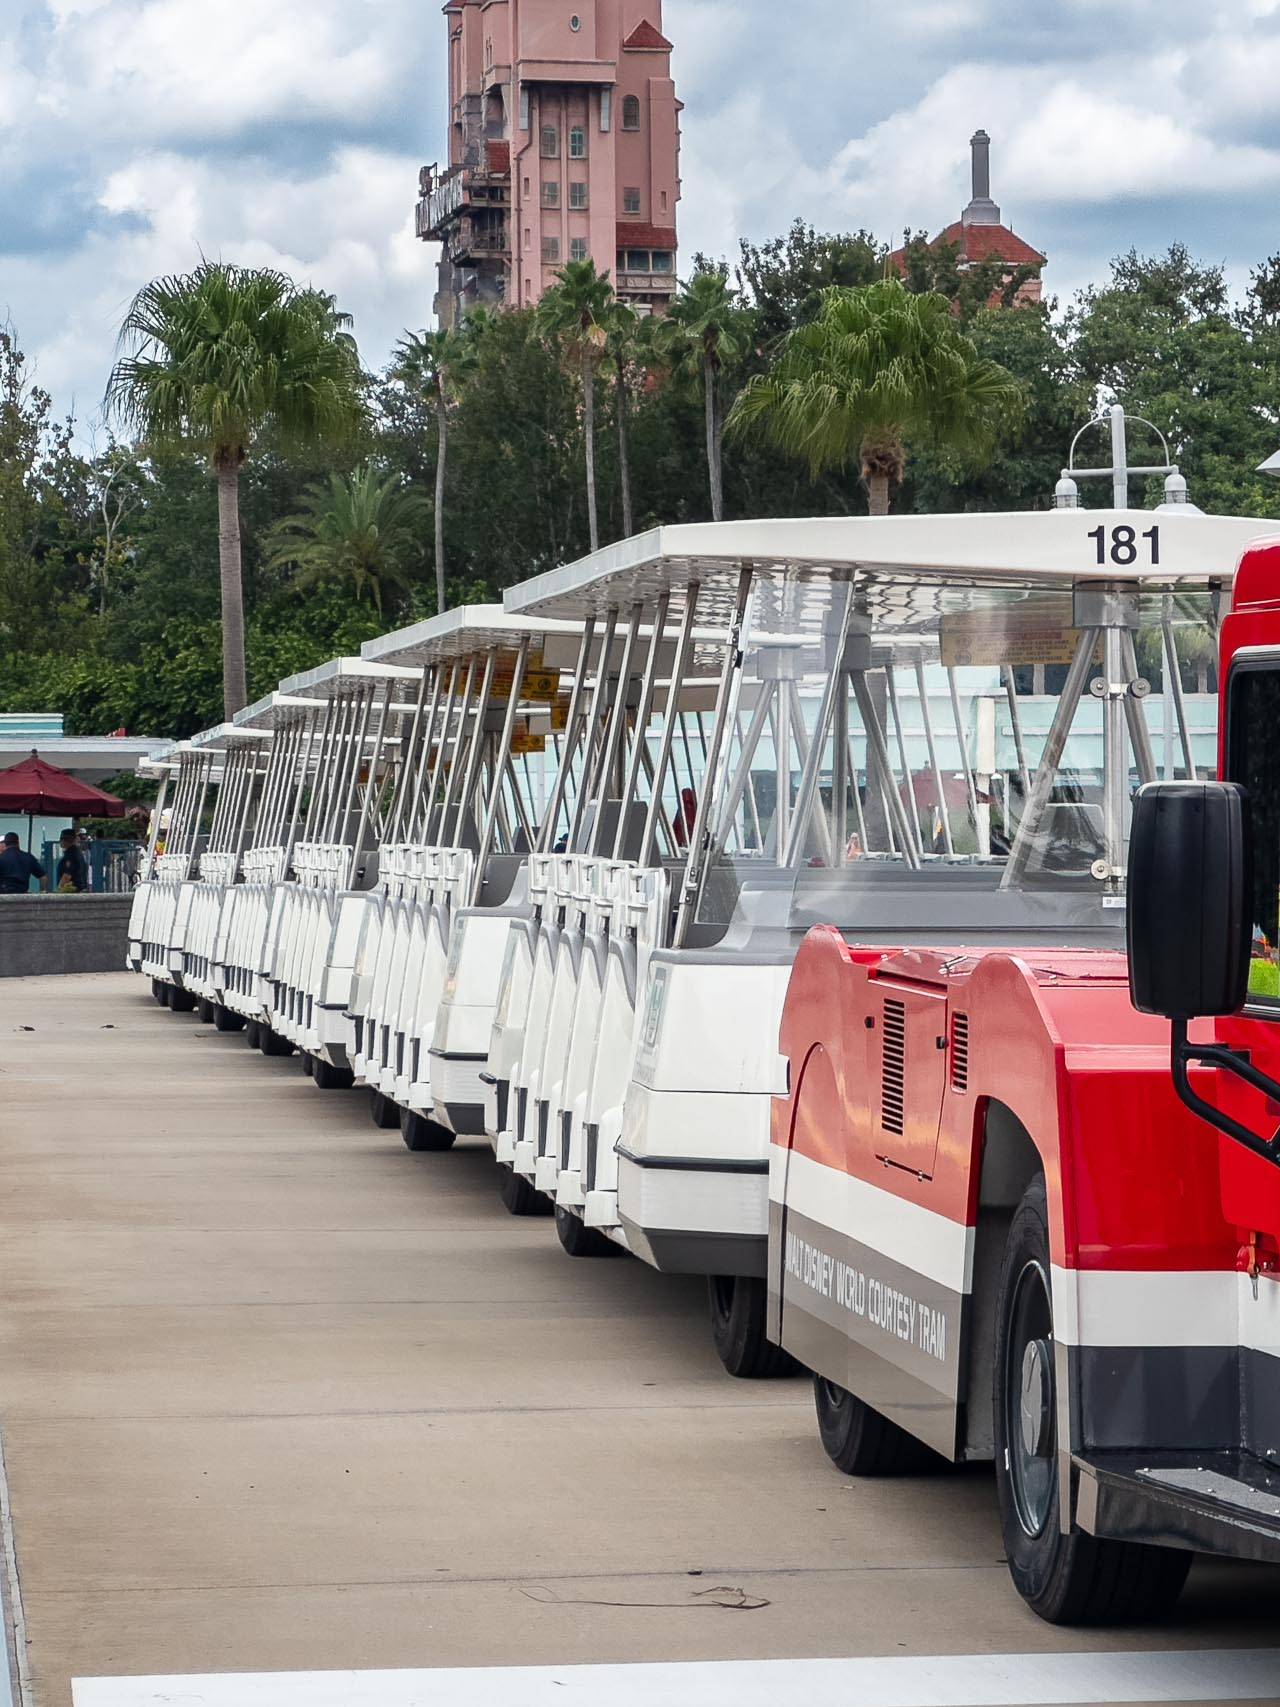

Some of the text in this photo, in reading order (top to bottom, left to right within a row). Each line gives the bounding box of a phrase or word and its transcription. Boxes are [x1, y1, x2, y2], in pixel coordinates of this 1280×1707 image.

[1088, 525, 1159, 565] 181
[785, 1231, 945, 1361] WALT DISNEY WORLD COURTESY TRAM
